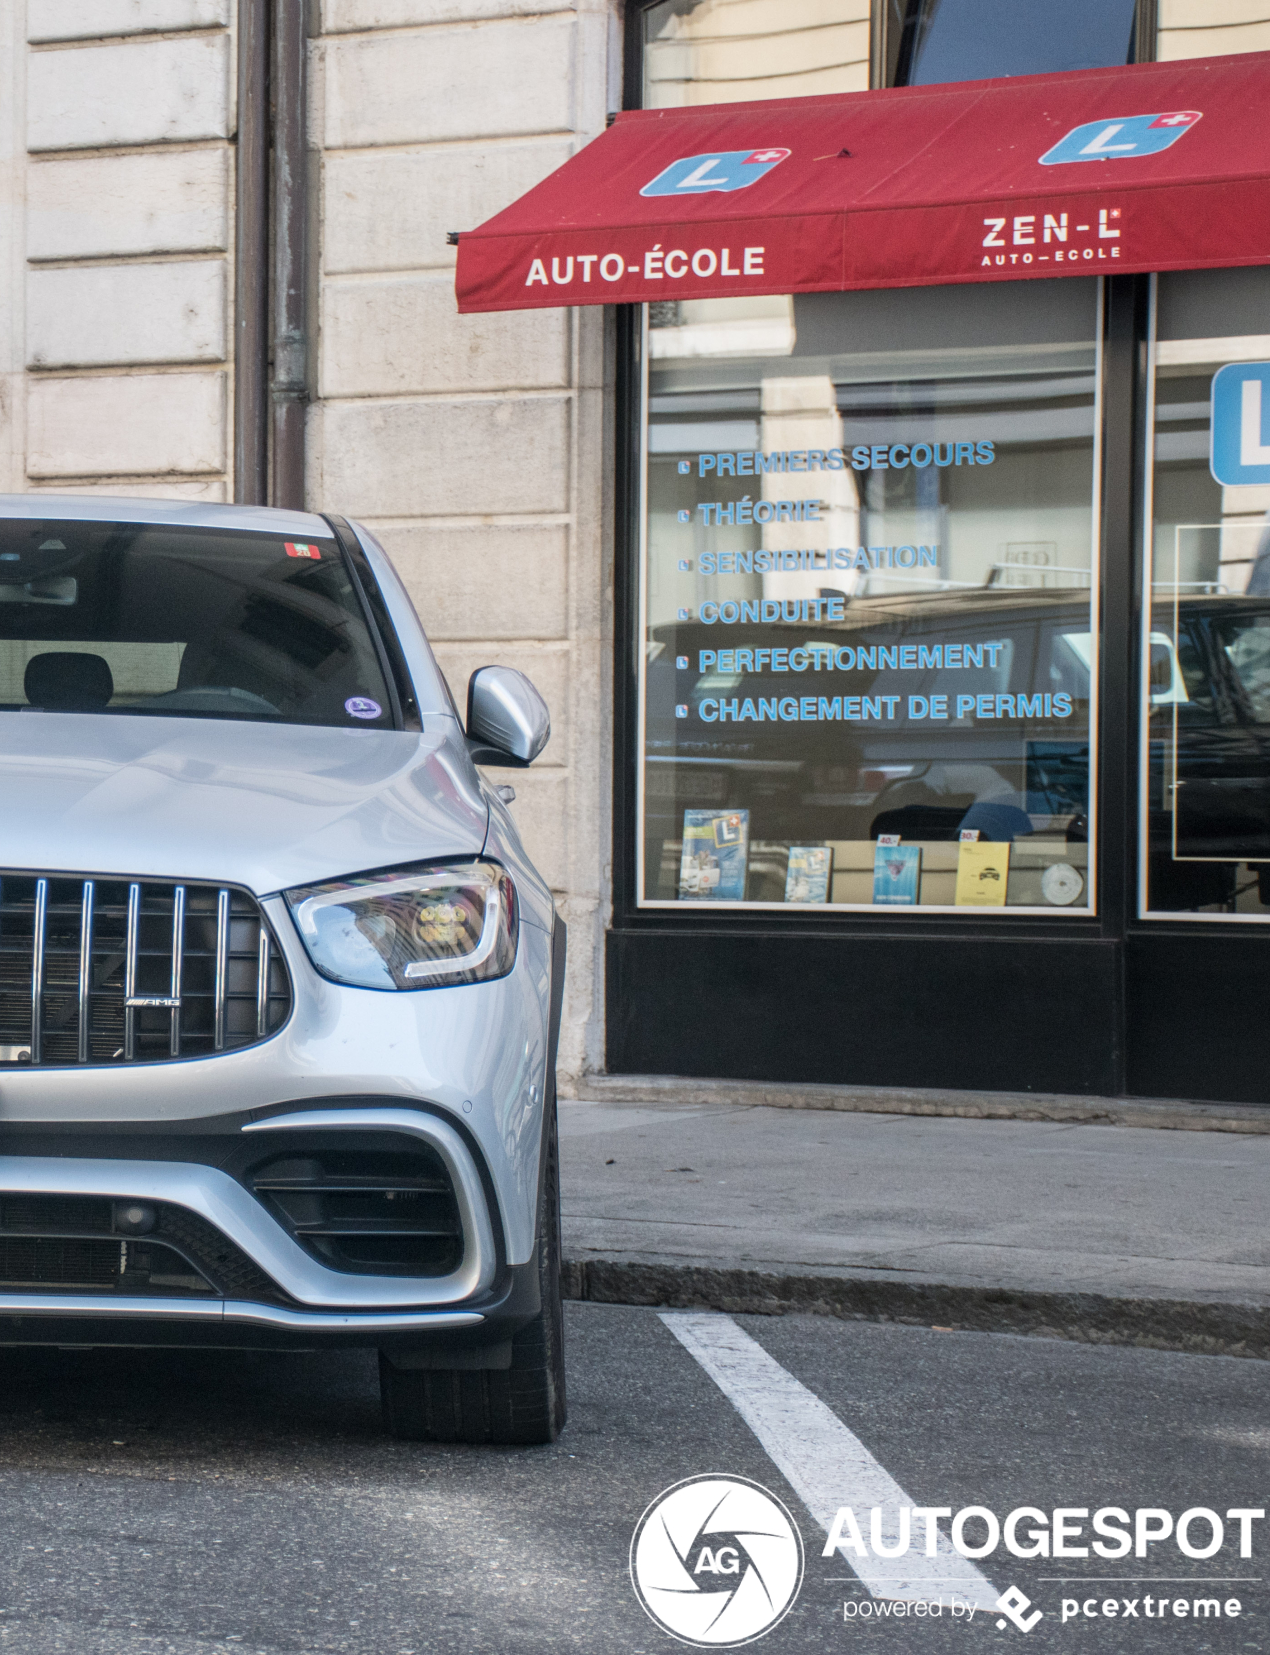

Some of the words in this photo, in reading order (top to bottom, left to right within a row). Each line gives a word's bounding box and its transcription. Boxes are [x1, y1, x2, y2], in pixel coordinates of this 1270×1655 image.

[1079, 124, 1138, 155] L
[676, 158, 729, 188] L
[982, 209, 1121, 248] ZEN-L
[525, 244, 765, 286] AUTO-ÉCOLE
[698, 448, 844, 478] PREMIERS
[851, 440, 995, 470] SECOURS
[697, 495, 821, 526] THÉORIE
[698, 545, 938, 575] SENSIBILISATION
[698, 597, 845, 625] CONDUITE
[699, 643, 1003, 673] PERFECTIONNEMENT
[698, 696, 900, 722] CHANGEMENT
[908, 695, 948, 720] DE
[956, 692, 1073, 719] PERMIS
